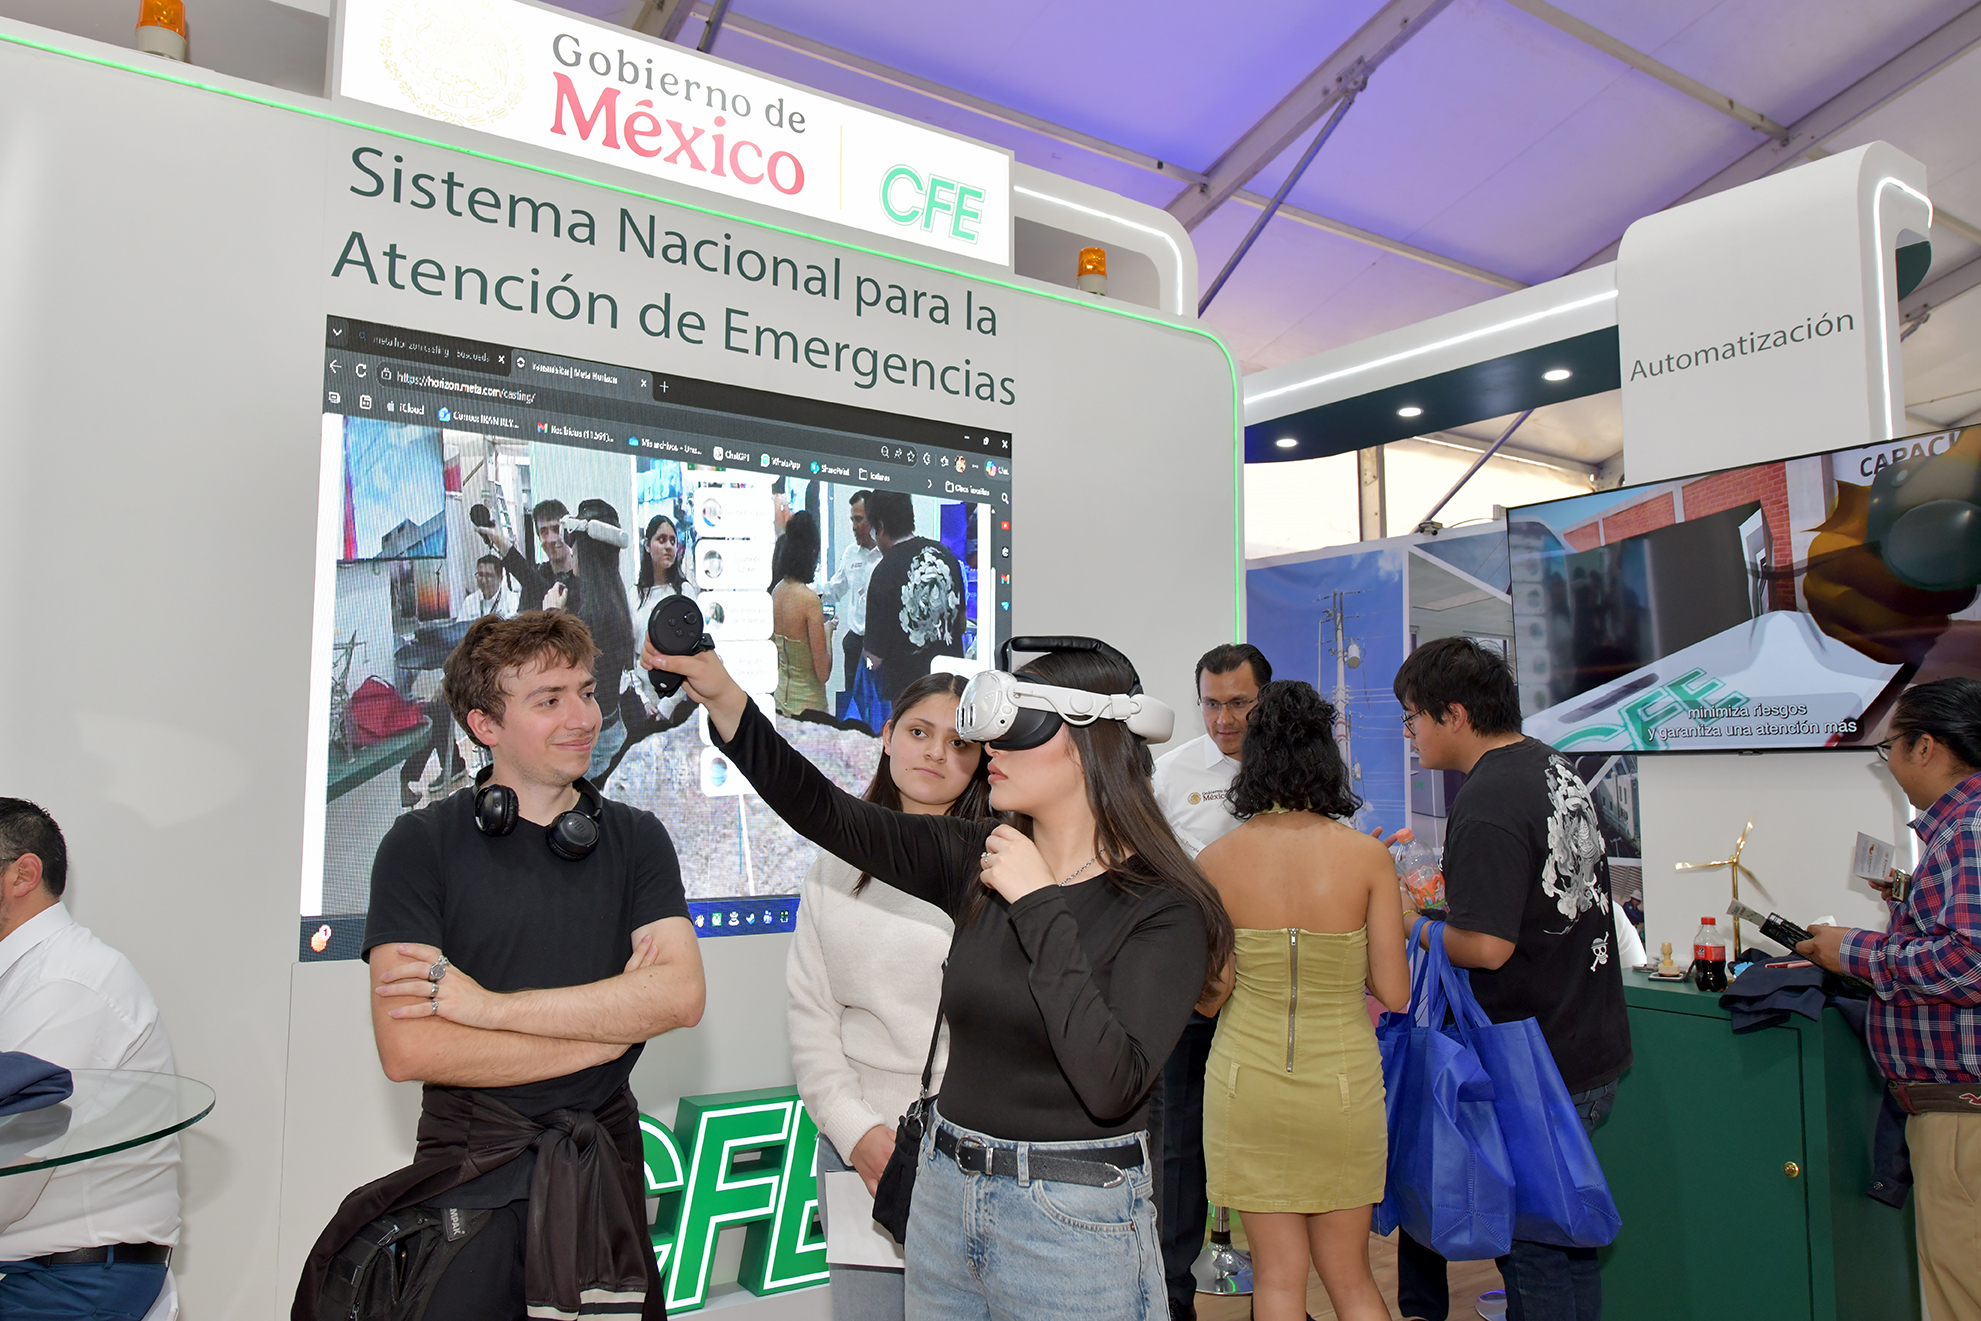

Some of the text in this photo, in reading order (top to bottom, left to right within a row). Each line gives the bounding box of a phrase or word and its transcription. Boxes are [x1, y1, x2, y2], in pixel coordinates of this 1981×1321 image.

[553, 34, 751, 117] Gobierno
[765, 98, 806, 134] de
[551, 72, 805, 195] México
[879, 164, 986, 245] CFE
[349, 146, 997, 337] Sistema Nacional para la
[331, 230, 1016, 406] Atención de Emergencias
[1630, 310, 1855, 382] Automatización
[399, 402, 425, 415] iCloud
[1647, 718, 1859, 742] y garantiza una atención más
[1687, 703, 1808, 720] minimiza riesgos
[1203, 792, 1227, 802] Méxic
[323, 927, 328, 937] 1
[449, 1208, 461, 1236] MPAK
